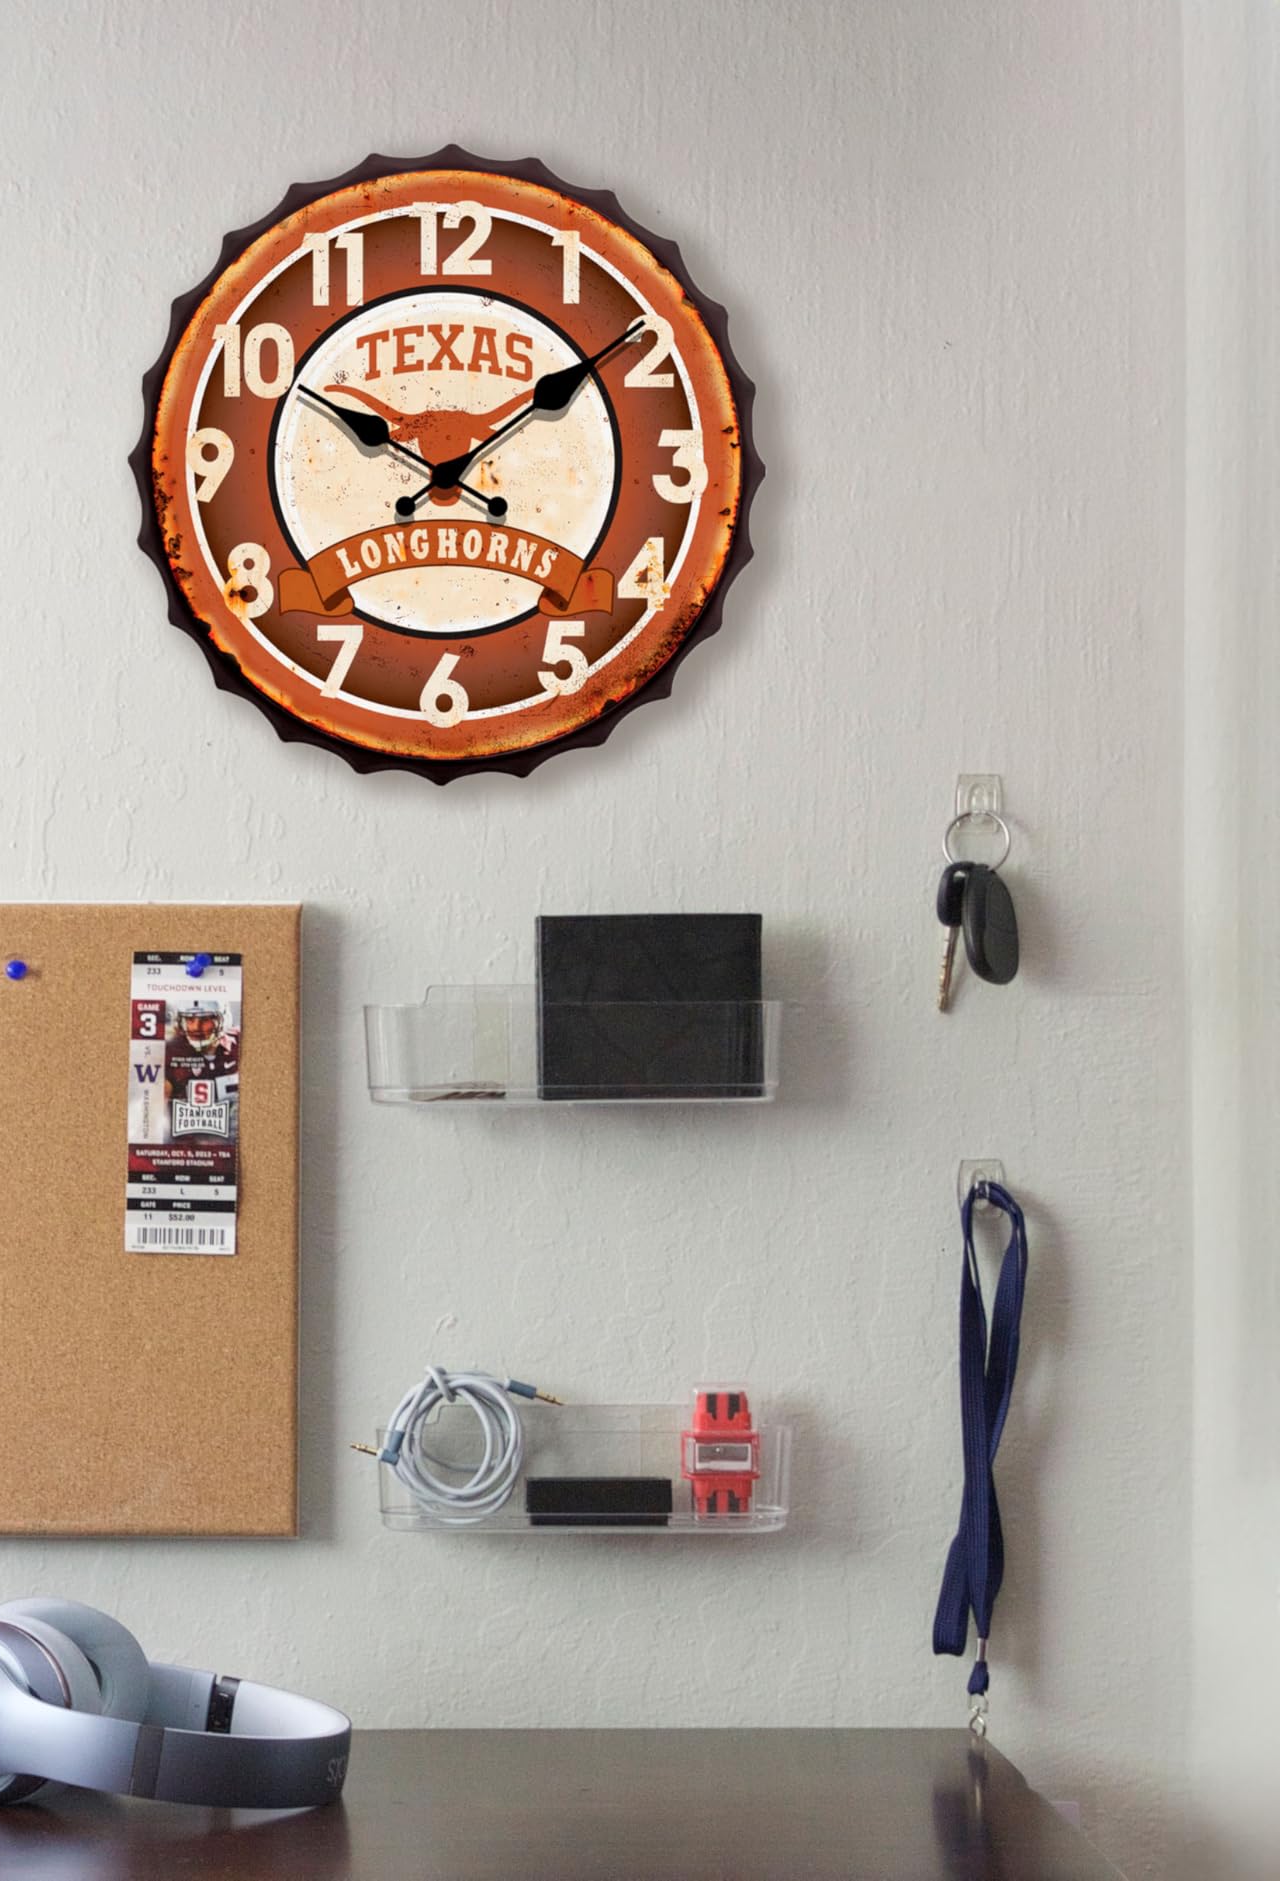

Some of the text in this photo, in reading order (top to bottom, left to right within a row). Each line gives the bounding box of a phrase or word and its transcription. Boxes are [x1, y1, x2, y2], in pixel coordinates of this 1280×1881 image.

[409, 201, 493, 275] 12
[551, 230, 580, 304] 1
[304, 232, 364, 306] 11
[213, 322, 295, 398] 10
[355, 323, 534, 382] TEXAS
[624, 313, 676, 389] 2
[186, 428, 235, 503] 9
[652, 429, 709, 504] 3
[224, 542, 274, 620] 8
[335, 528, 559, 580] LONGHORNS
[618, 537, 671, 611] 4
[317, 625, 364, 698] 7
[537, 620, 588, 697] 5
[419, 653, 469, 728] 6
[146, 967, 161, 975] 233
[147, 984, 201, 992] TOUCHDOWN
[137, 1003, 160, 1012] GAME
[139, 1013, 157, 1038] 3
[133, 1064, 162, 1083] W
[194, 1082, 208, 1104] S
[178, 1106, 223, 1119] STANFORD
[178, 1119, 223, 1130] FOOTBALL
[135, 1149, 171, 1158] SATURDAY,
[171, 1150, 186, 1158] OCT.
[186, 1159, 214, 1167] STADIUM
[168, 1213, 195, 1221] $52.00
